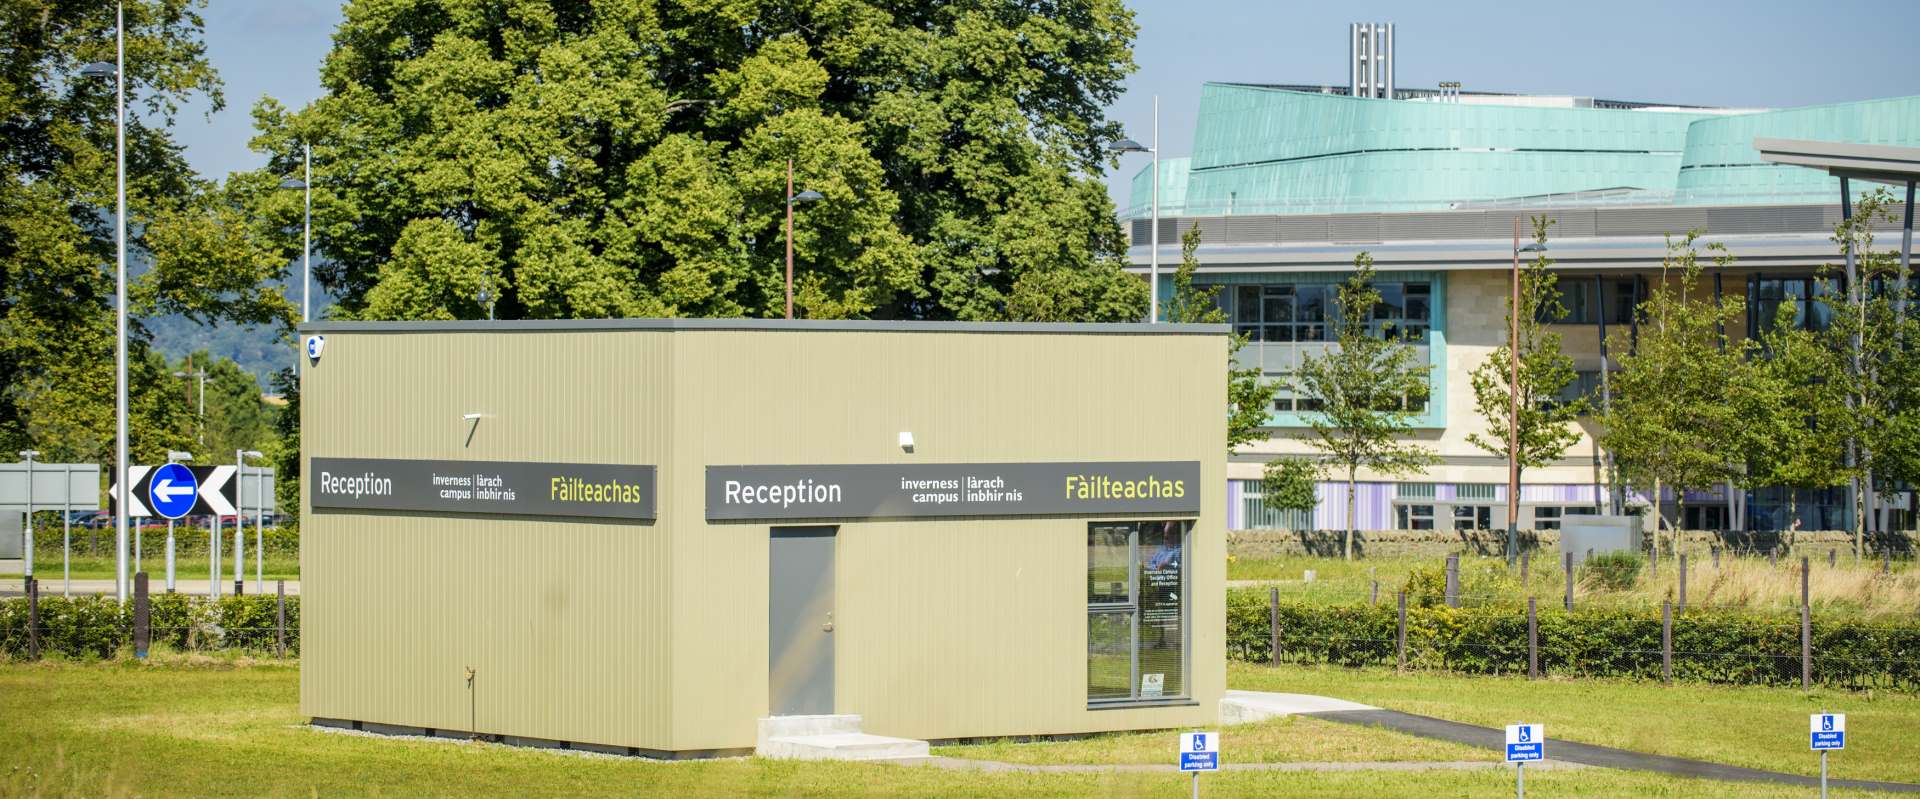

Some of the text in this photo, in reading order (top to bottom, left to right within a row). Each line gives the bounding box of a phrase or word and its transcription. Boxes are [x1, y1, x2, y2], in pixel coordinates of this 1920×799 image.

[321, 471, 392, 499] Reception
[432, 472, 472, 486] inverness
[476, 474, 503, 487] làrach
[901, 477, 959, 490] inverness
[967, 476, 1004, 489] làrach
[551, 476, 641, 503] Fàilteachas
[725, 478, 841, 509] Reception
[1066, 475, 1185, 499] Fàilteachas
[440, 489, 472, 501] campus
[476, 487, 516, 501] inbhir nis
[912, 493, 959, 505] campus
[967, 489, 1023, 502] inbhir nis
